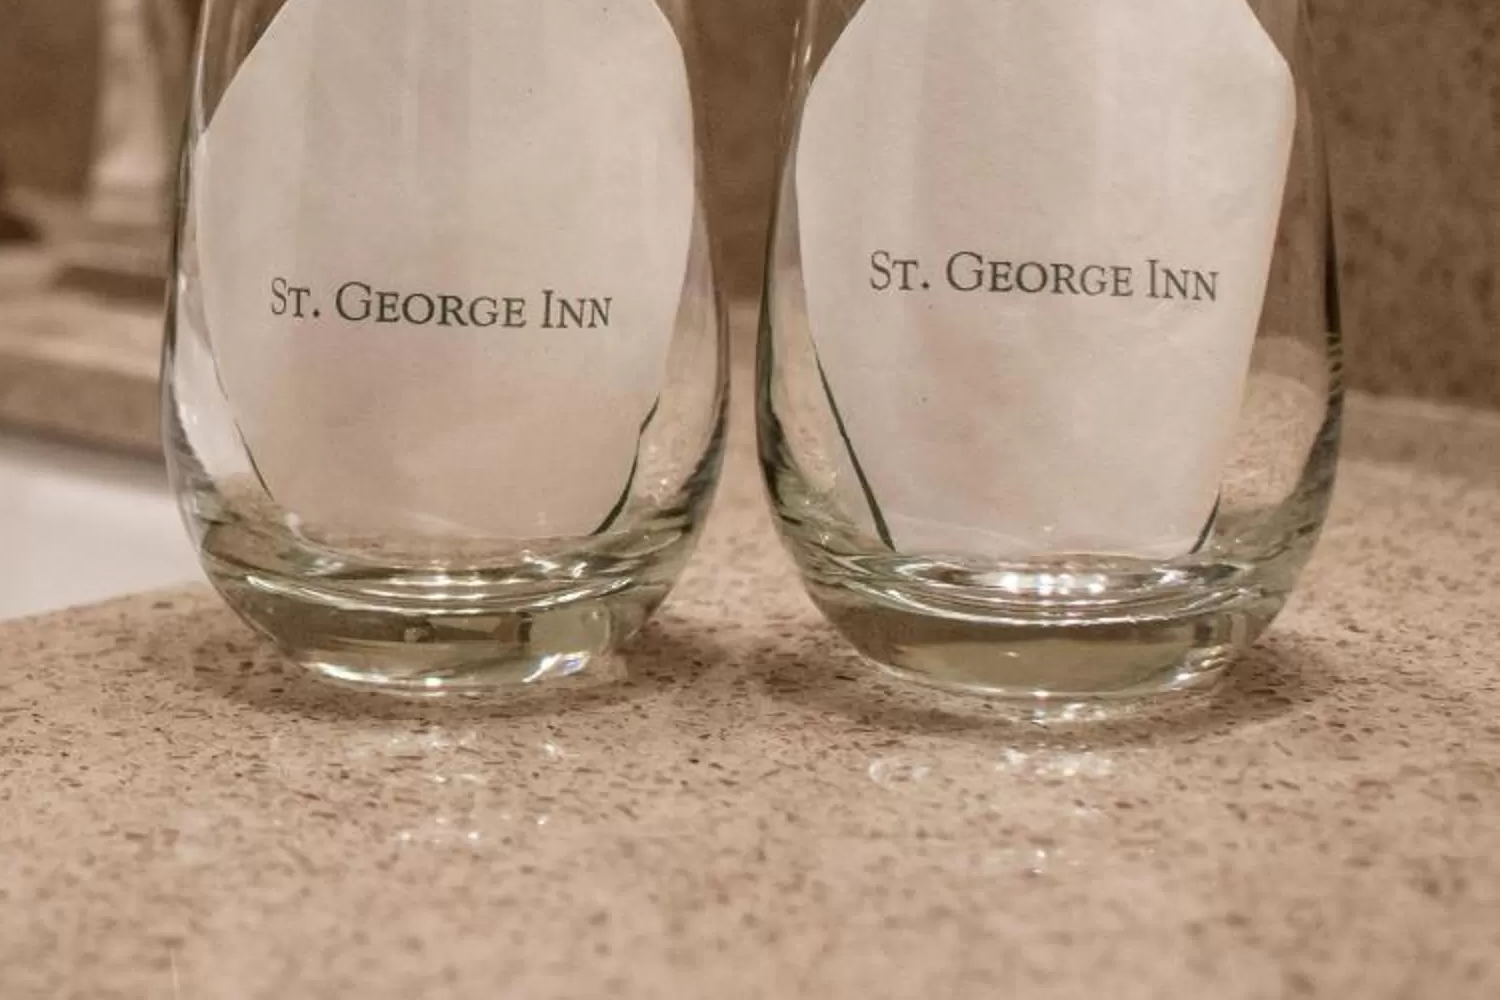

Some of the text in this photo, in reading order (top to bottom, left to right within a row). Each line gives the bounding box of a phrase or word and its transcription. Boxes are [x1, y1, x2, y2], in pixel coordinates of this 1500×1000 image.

[870, 250, 1220, 302] ST. GEORGE INN
[270, 277, 613, 329] ST. GEORGE INN
